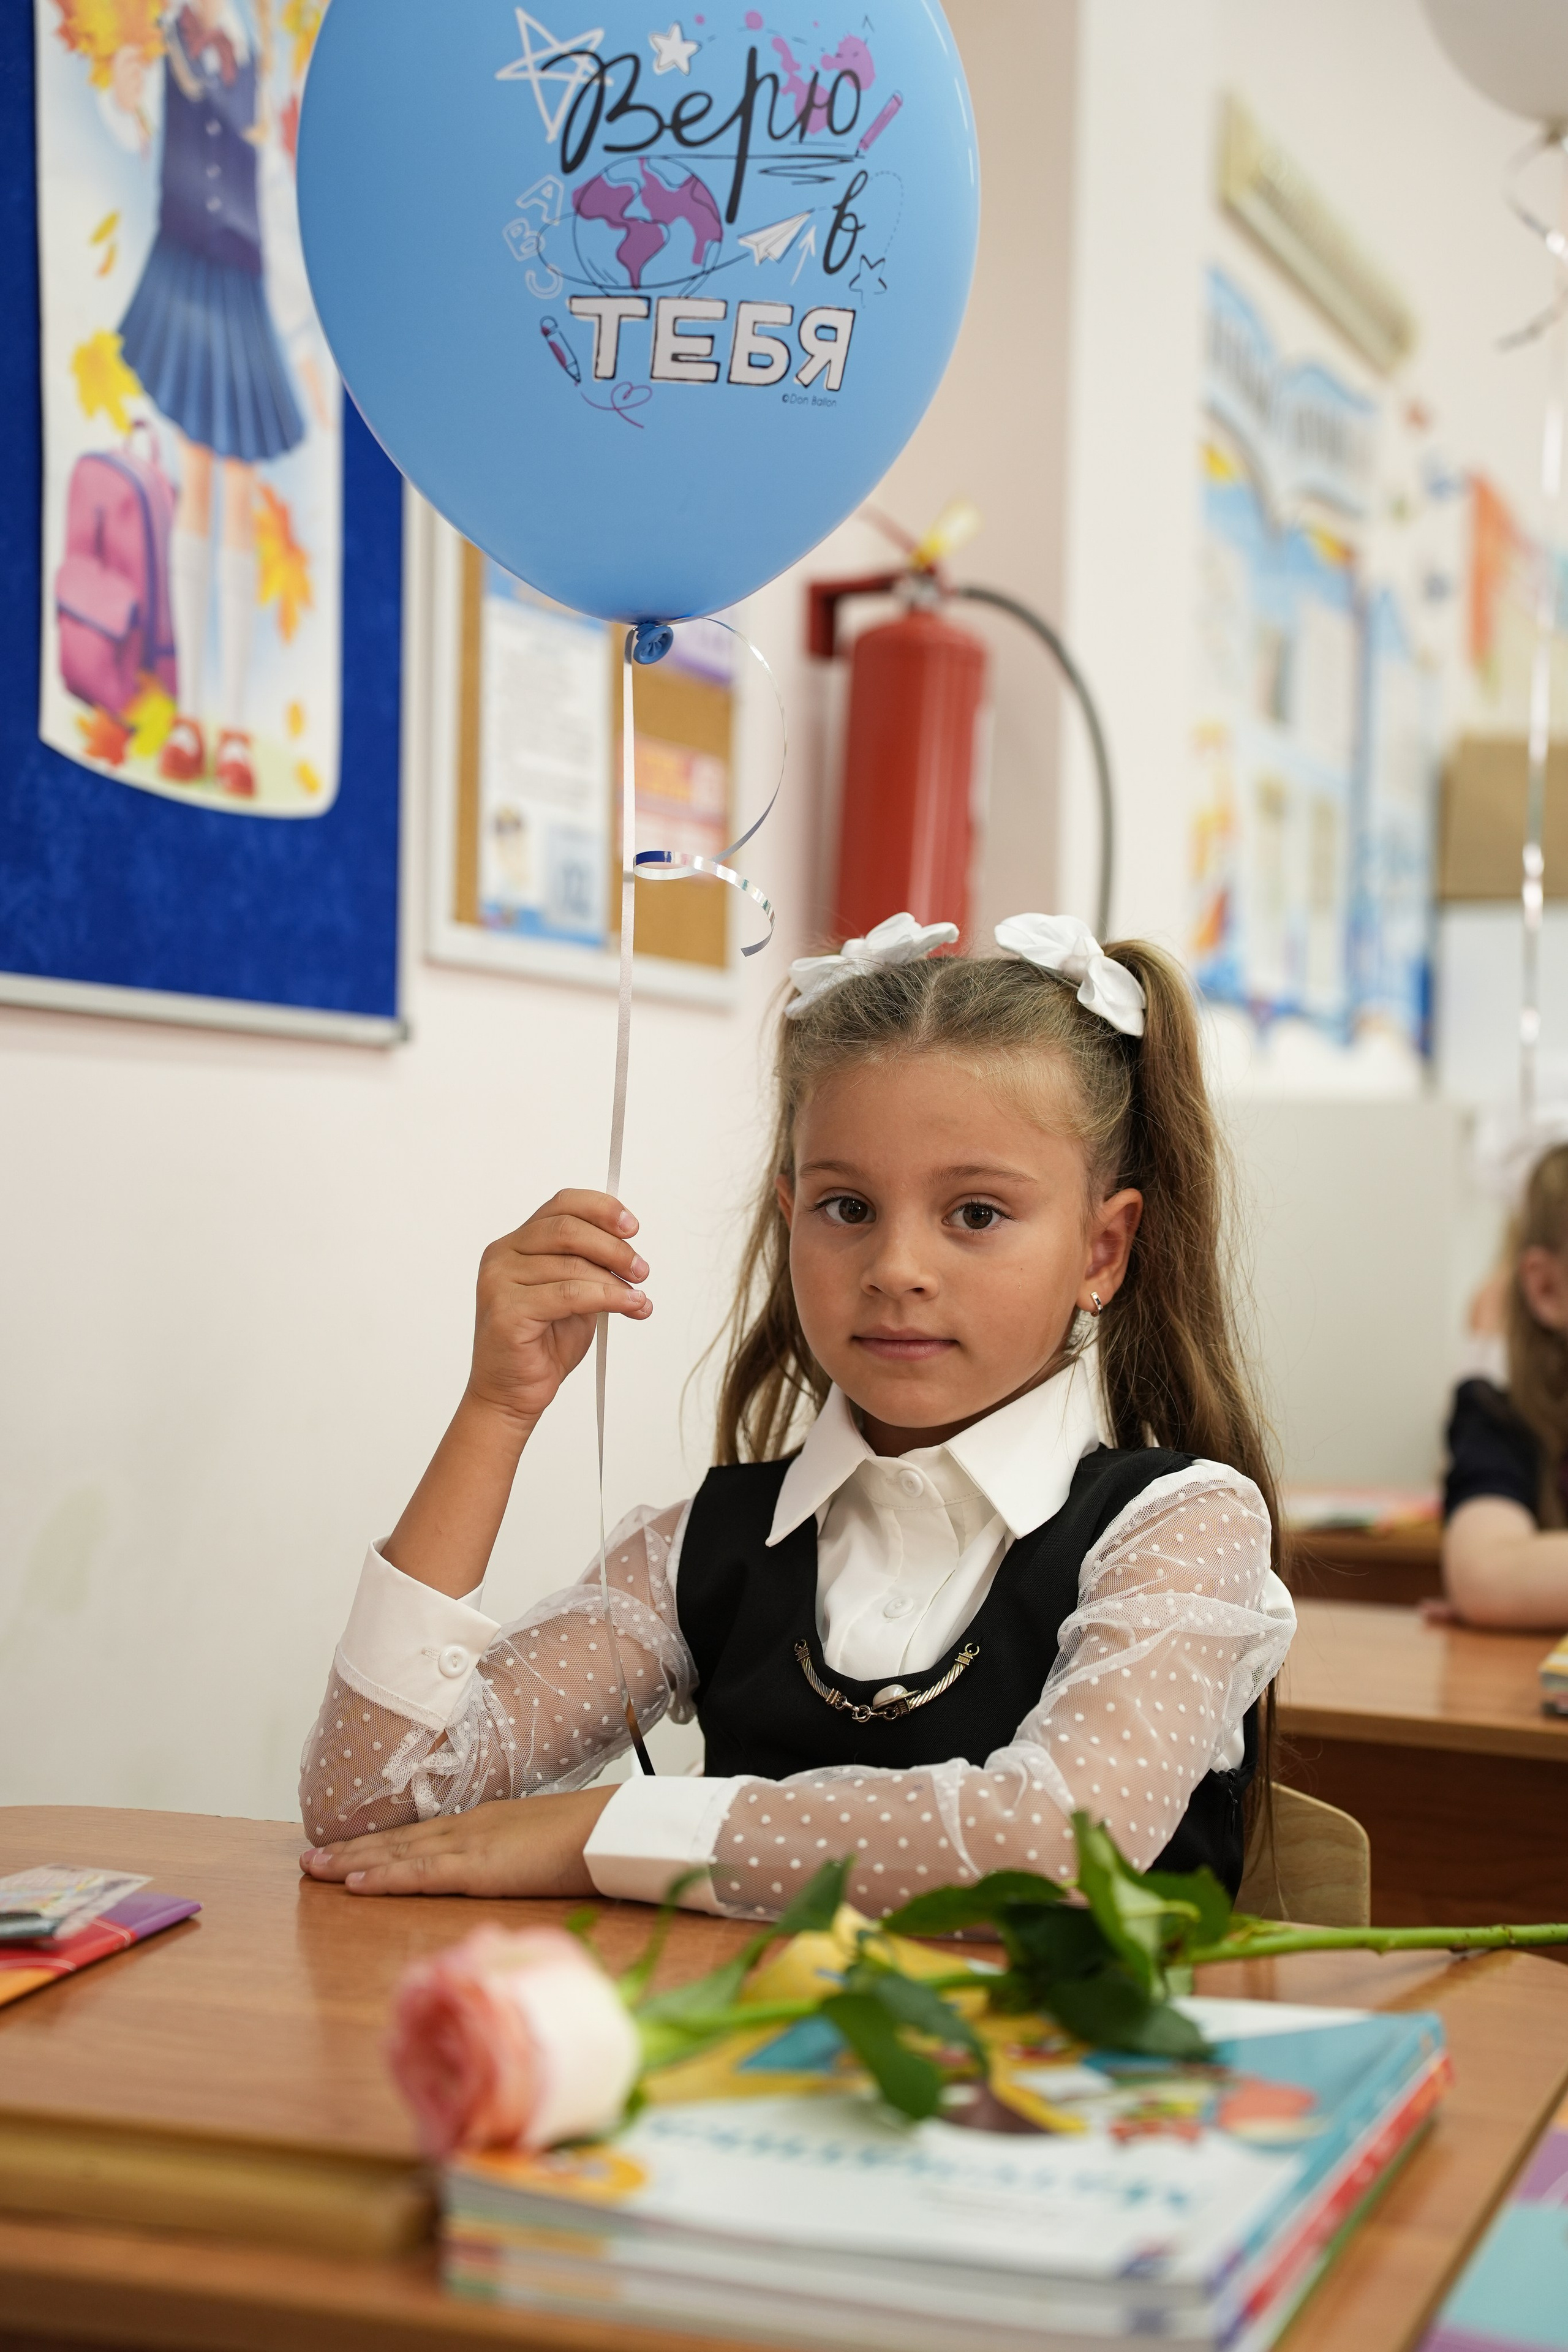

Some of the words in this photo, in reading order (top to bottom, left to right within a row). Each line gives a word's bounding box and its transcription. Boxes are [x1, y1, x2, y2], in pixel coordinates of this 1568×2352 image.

[541, 46, 861, 224] Верю
[823, 169, 869, 275] в
[567, 294, 856, 391] ТЕБЯ
